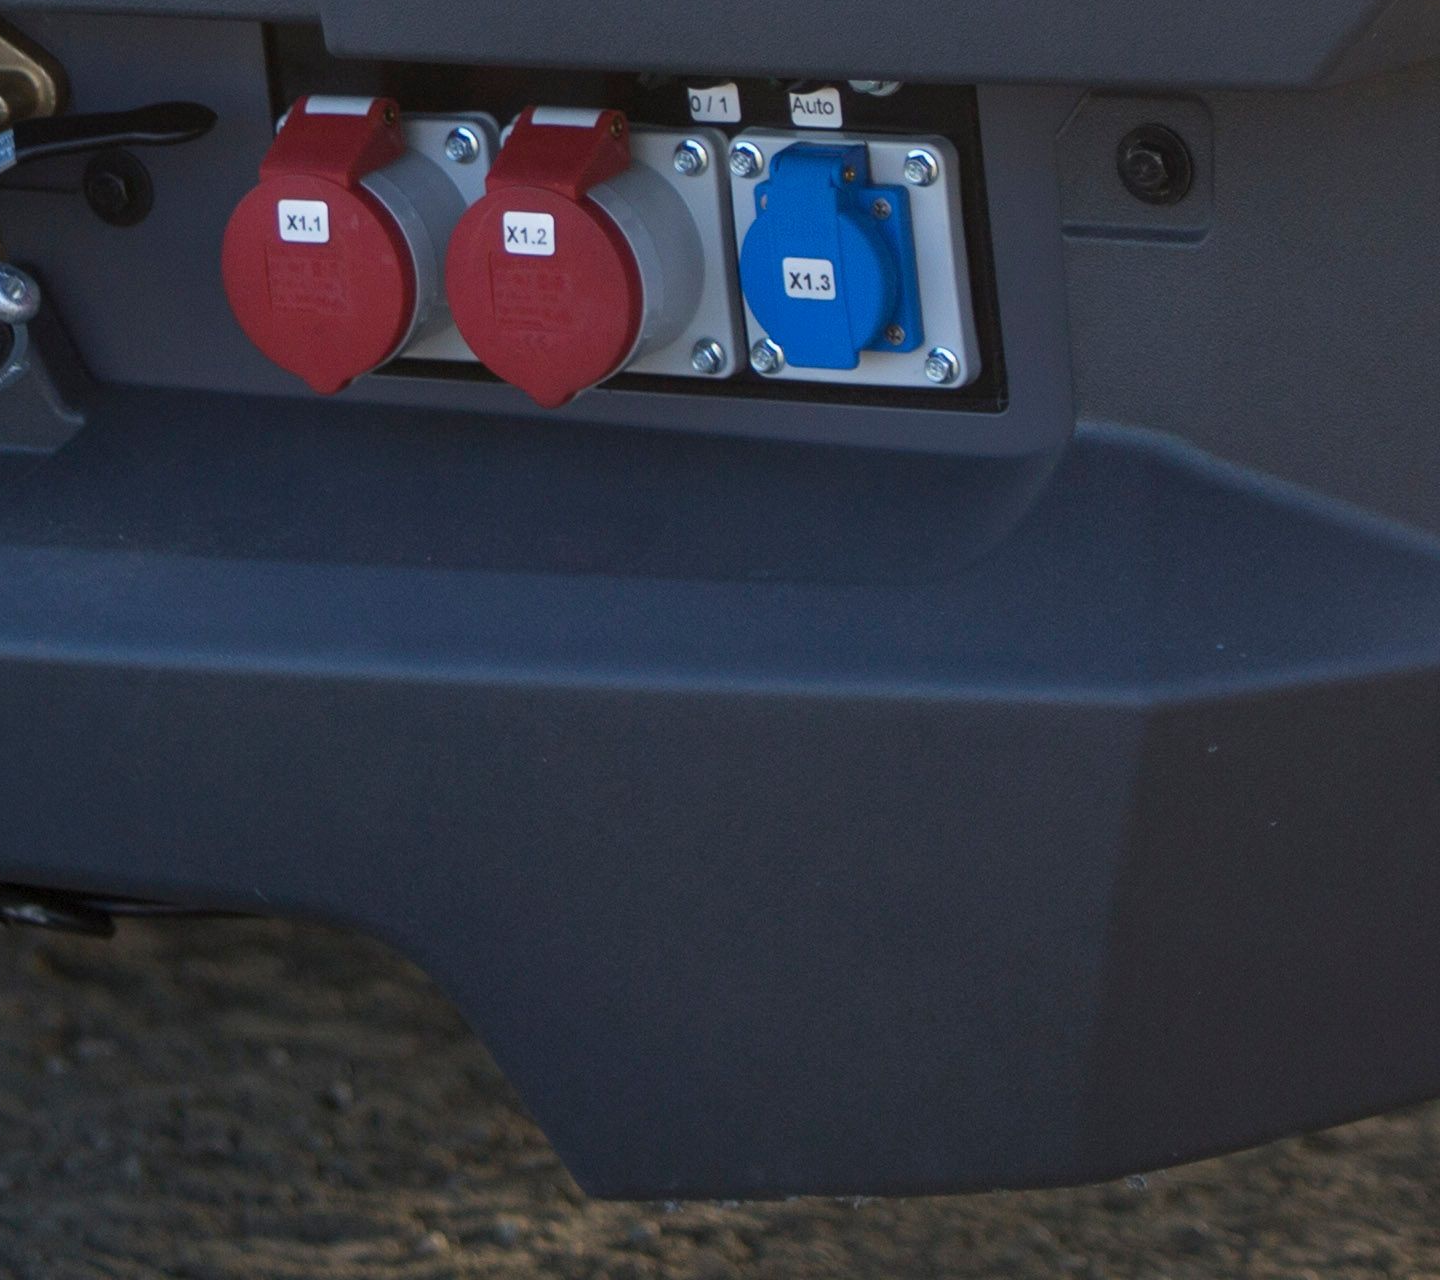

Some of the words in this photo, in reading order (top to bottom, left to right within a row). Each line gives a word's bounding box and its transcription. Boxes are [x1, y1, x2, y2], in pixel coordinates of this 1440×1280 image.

[719, 97, 728, 114] 1
[791, 97, 835, 116] Auto
[286, 214, 321, 232] X1.1
[506, 225, 548, 246] X1.2
[788, 271, 831, 291] X1.3
